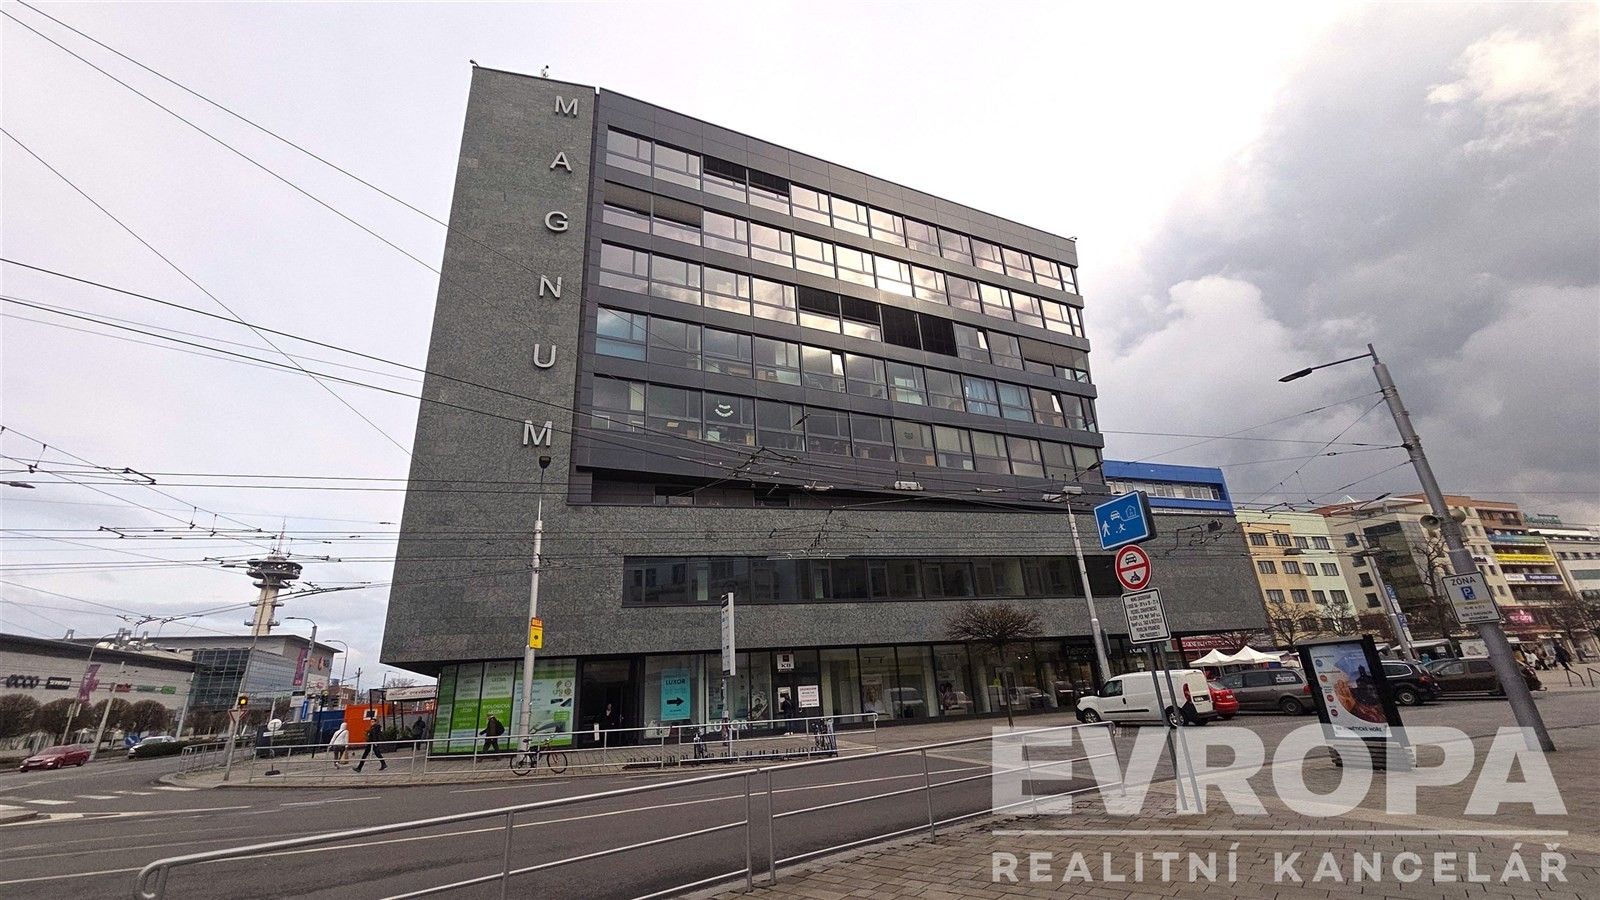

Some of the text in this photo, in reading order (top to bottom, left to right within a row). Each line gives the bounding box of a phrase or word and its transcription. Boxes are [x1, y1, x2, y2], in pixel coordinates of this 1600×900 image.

[522, 95, 579, 447] MAGNUM
[1451, 576, 1476, 586] ZÓNA
[665, 678, 686, 686] LUXOR
[706, 719, 748, 734] LUOR
